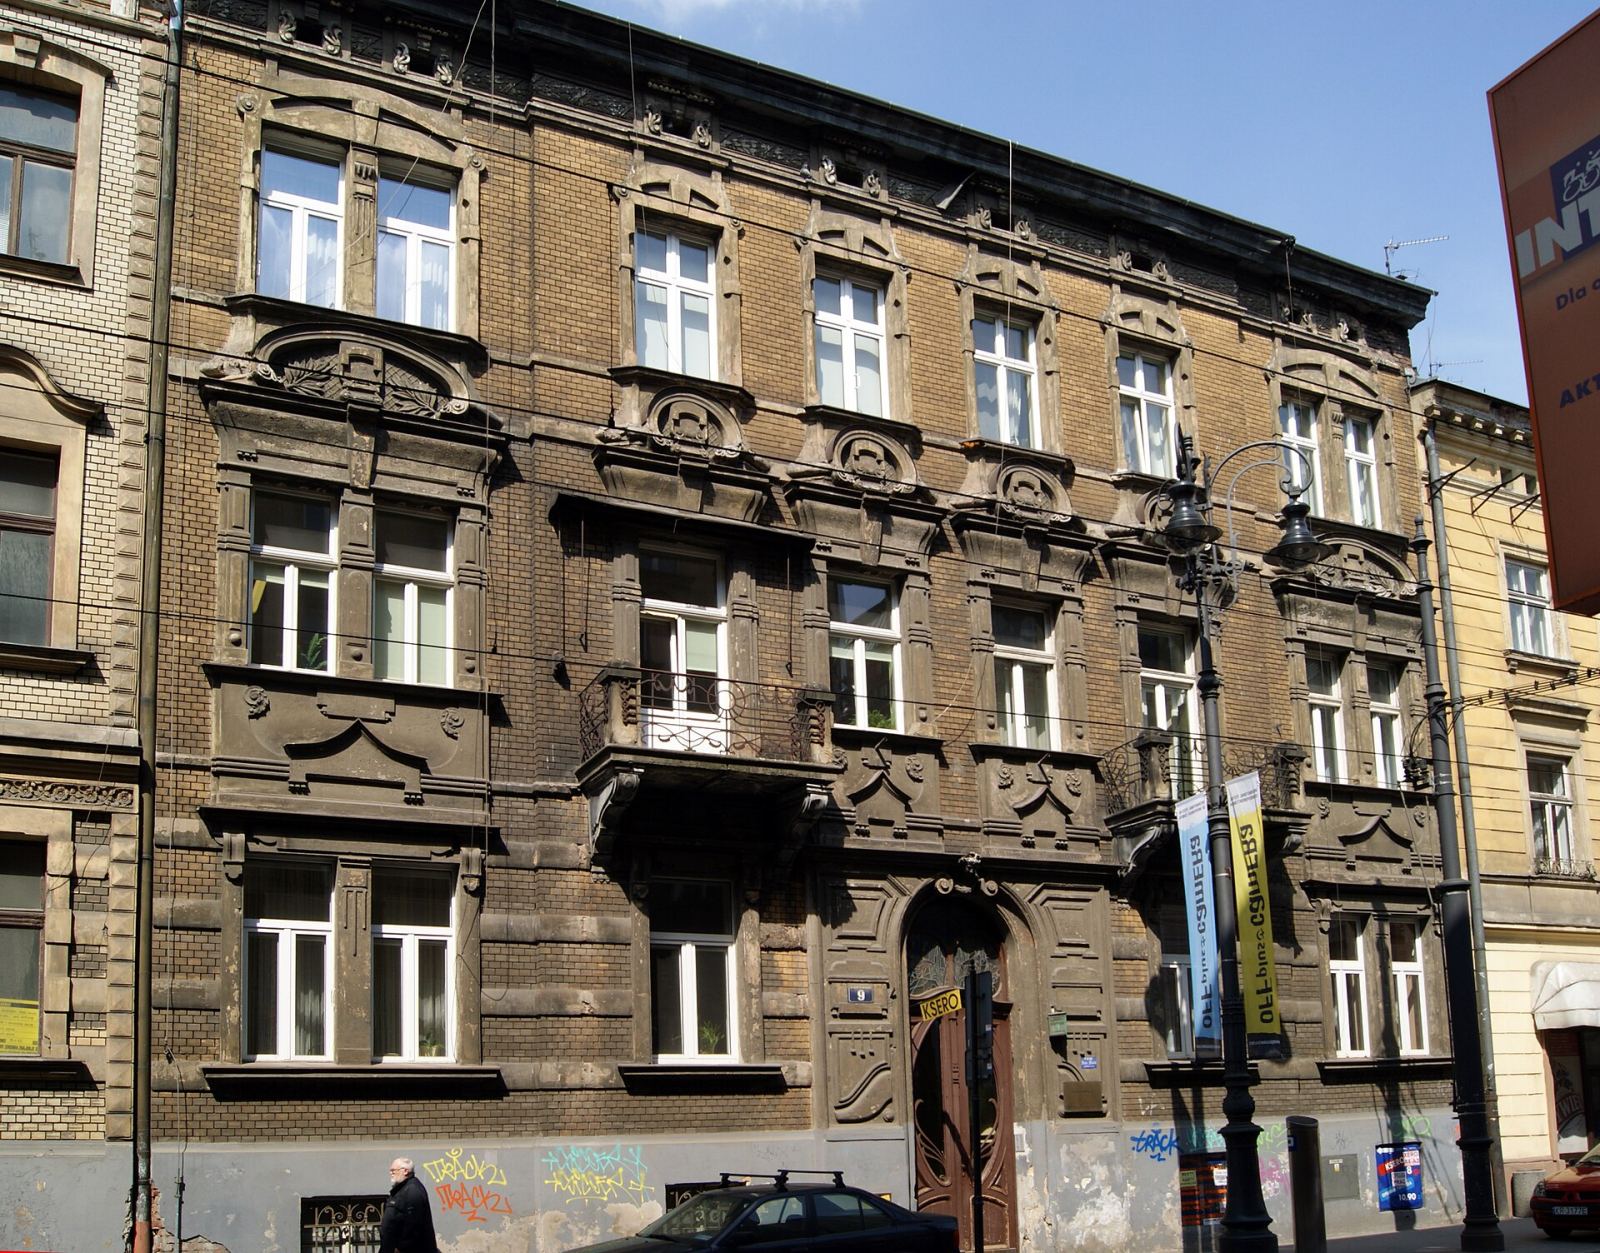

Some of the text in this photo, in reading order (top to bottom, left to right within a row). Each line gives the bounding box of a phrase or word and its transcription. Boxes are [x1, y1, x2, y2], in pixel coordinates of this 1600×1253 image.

[1556, 286, 1588, 311] Dla
[857, 989, 866, 1001] 9
[923, 993, 959, 1020] KSERO
